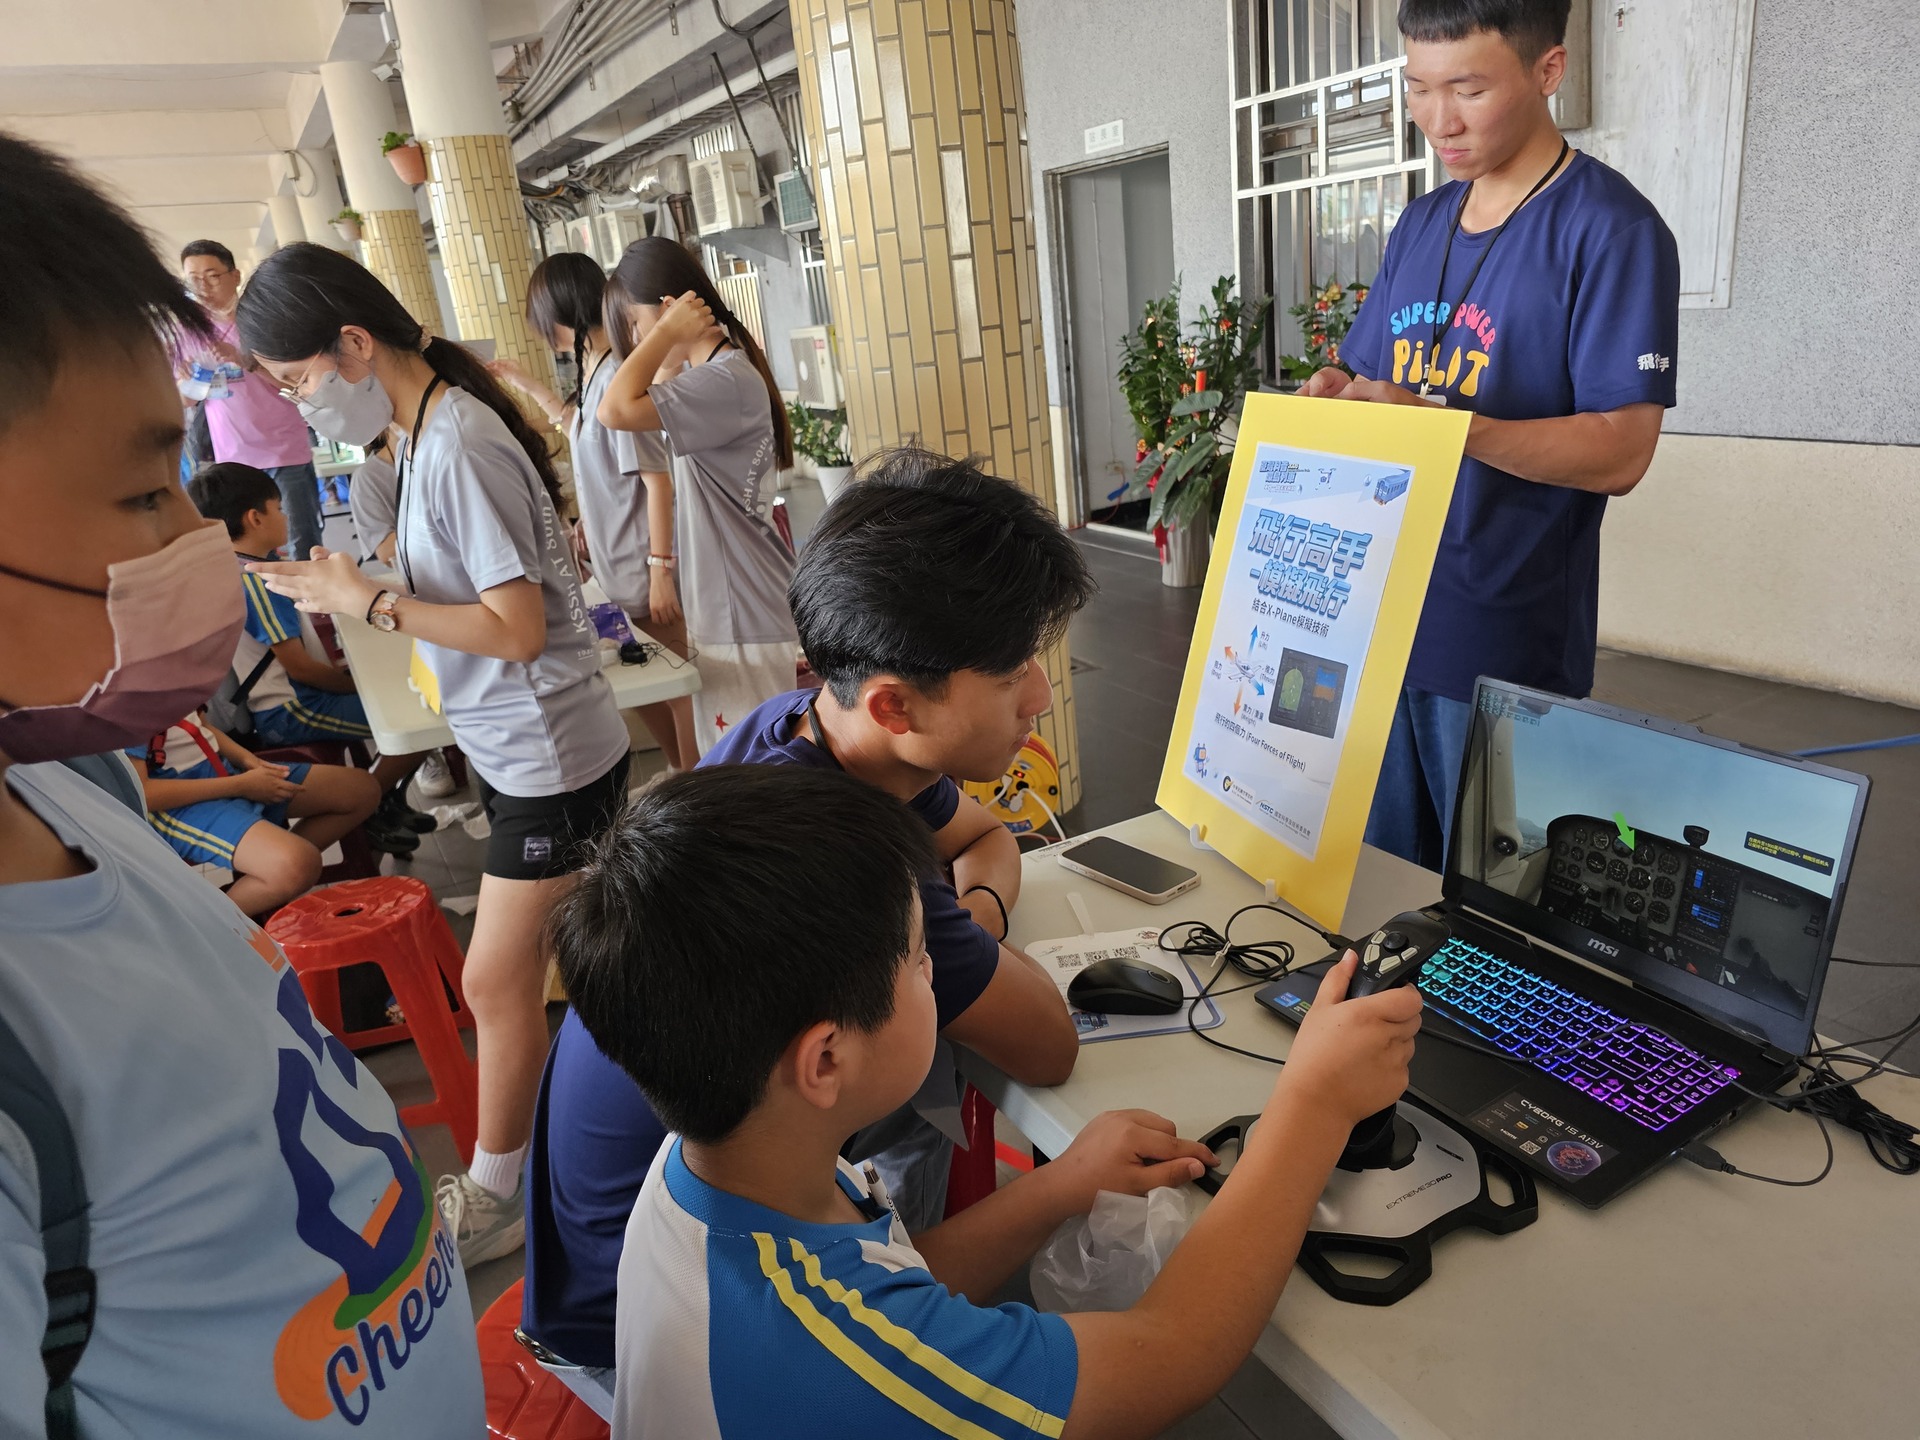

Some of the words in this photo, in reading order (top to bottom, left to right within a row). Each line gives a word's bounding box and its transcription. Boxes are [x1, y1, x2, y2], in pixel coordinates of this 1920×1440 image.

[1390, 301, 1451, 335] SUPER
[747, 470, 758, 486] AT
[1248, 509, 1373, 579] 飛行高手
[551, 556, 573, 577] AT
[568, 582, 588, 633] KSSH
[1260, 739, 1278, 756] Forces
[1286, 753, 1306, 772] Flight)
[1260, 802, 1274, 814] NSTC
[1587, 938, 1619, 957] msi
[1520, 1099, 1564, 1127] CYBORG
[1565, 1125, 1579, 1136] 15
